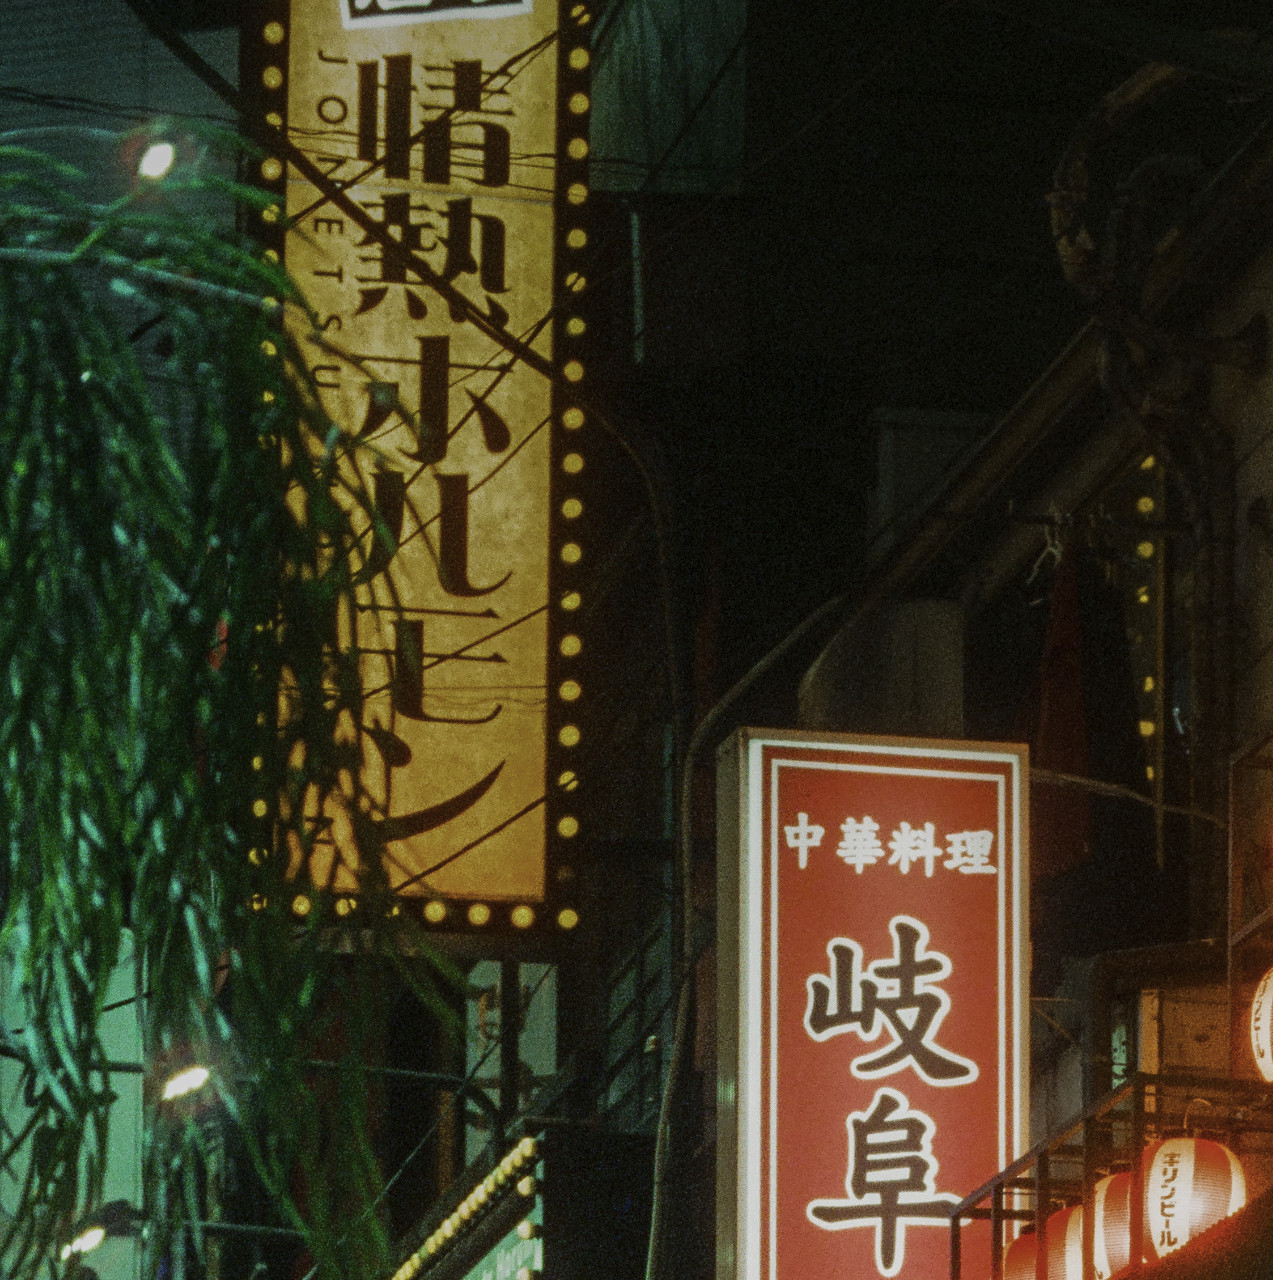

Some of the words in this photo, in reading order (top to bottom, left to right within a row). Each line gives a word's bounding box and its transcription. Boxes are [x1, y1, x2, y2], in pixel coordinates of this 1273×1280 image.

[355, 53, 516, 843] 情熱ホルモン
[783, 812, 998, 876] 中華料理
[1160, 1152, 1182, 1248] キリンビール
